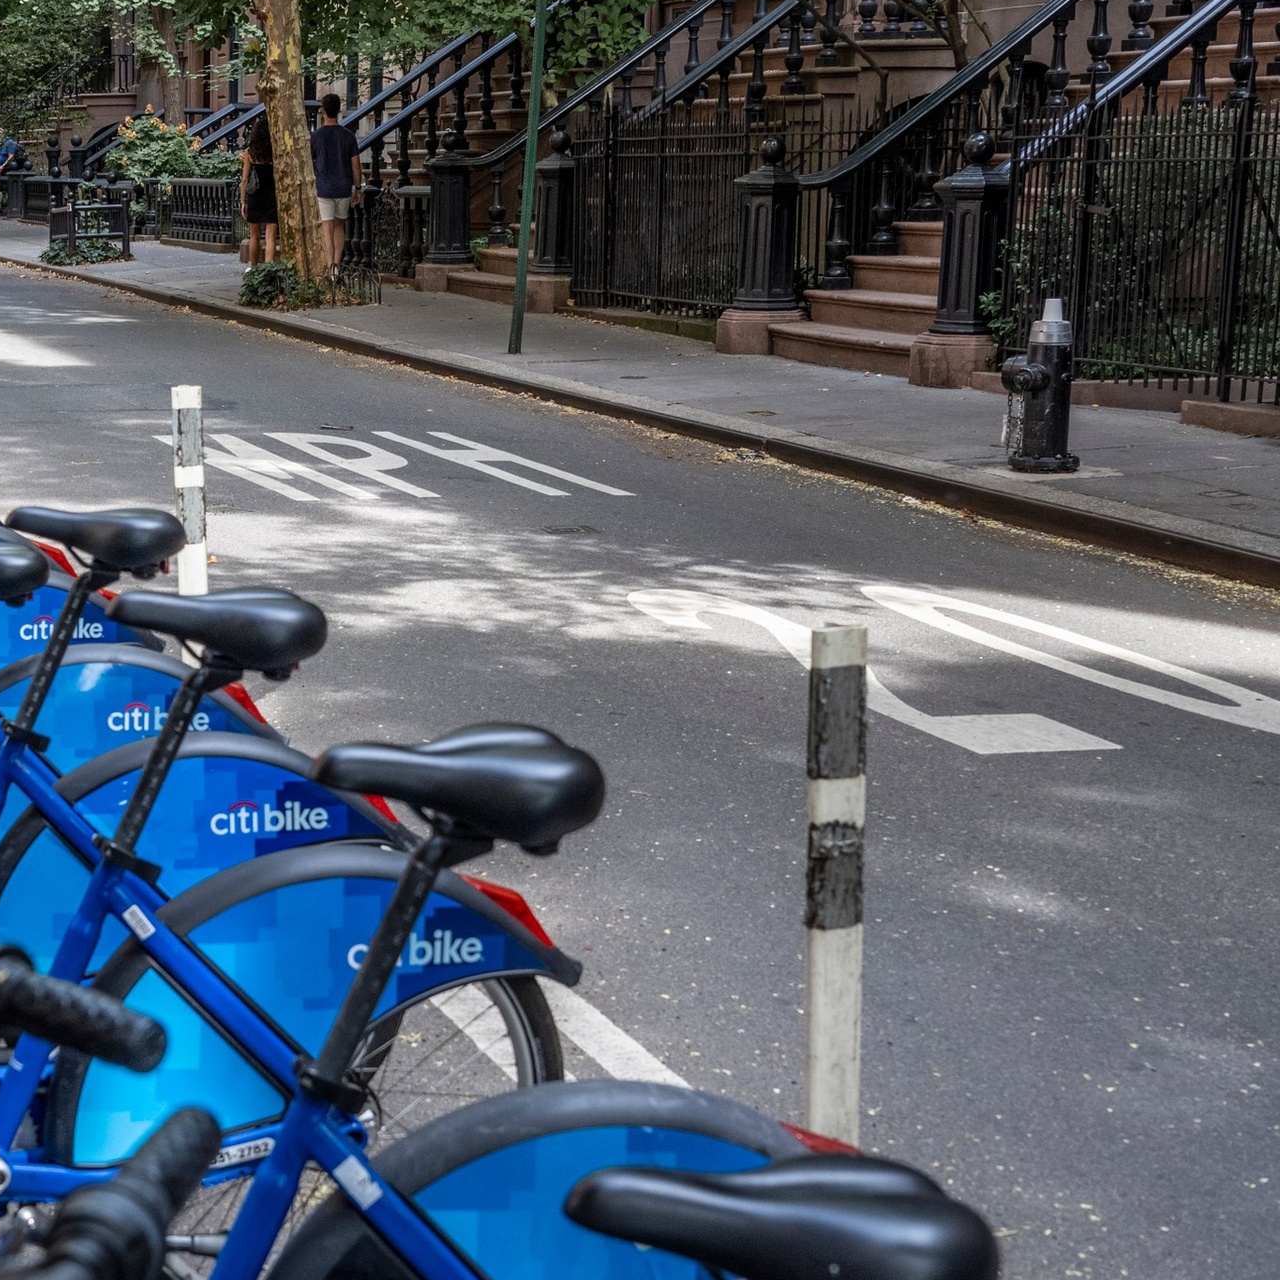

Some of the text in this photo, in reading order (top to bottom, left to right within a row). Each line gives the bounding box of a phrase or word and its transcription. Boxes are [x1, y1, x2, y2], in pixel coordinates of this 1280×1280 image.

[152, 431, 635, 501] MPH
[154, 706, 209, 731] be
[264, 800, 329, 833] bike
[409, 929, 483, 967] bike
